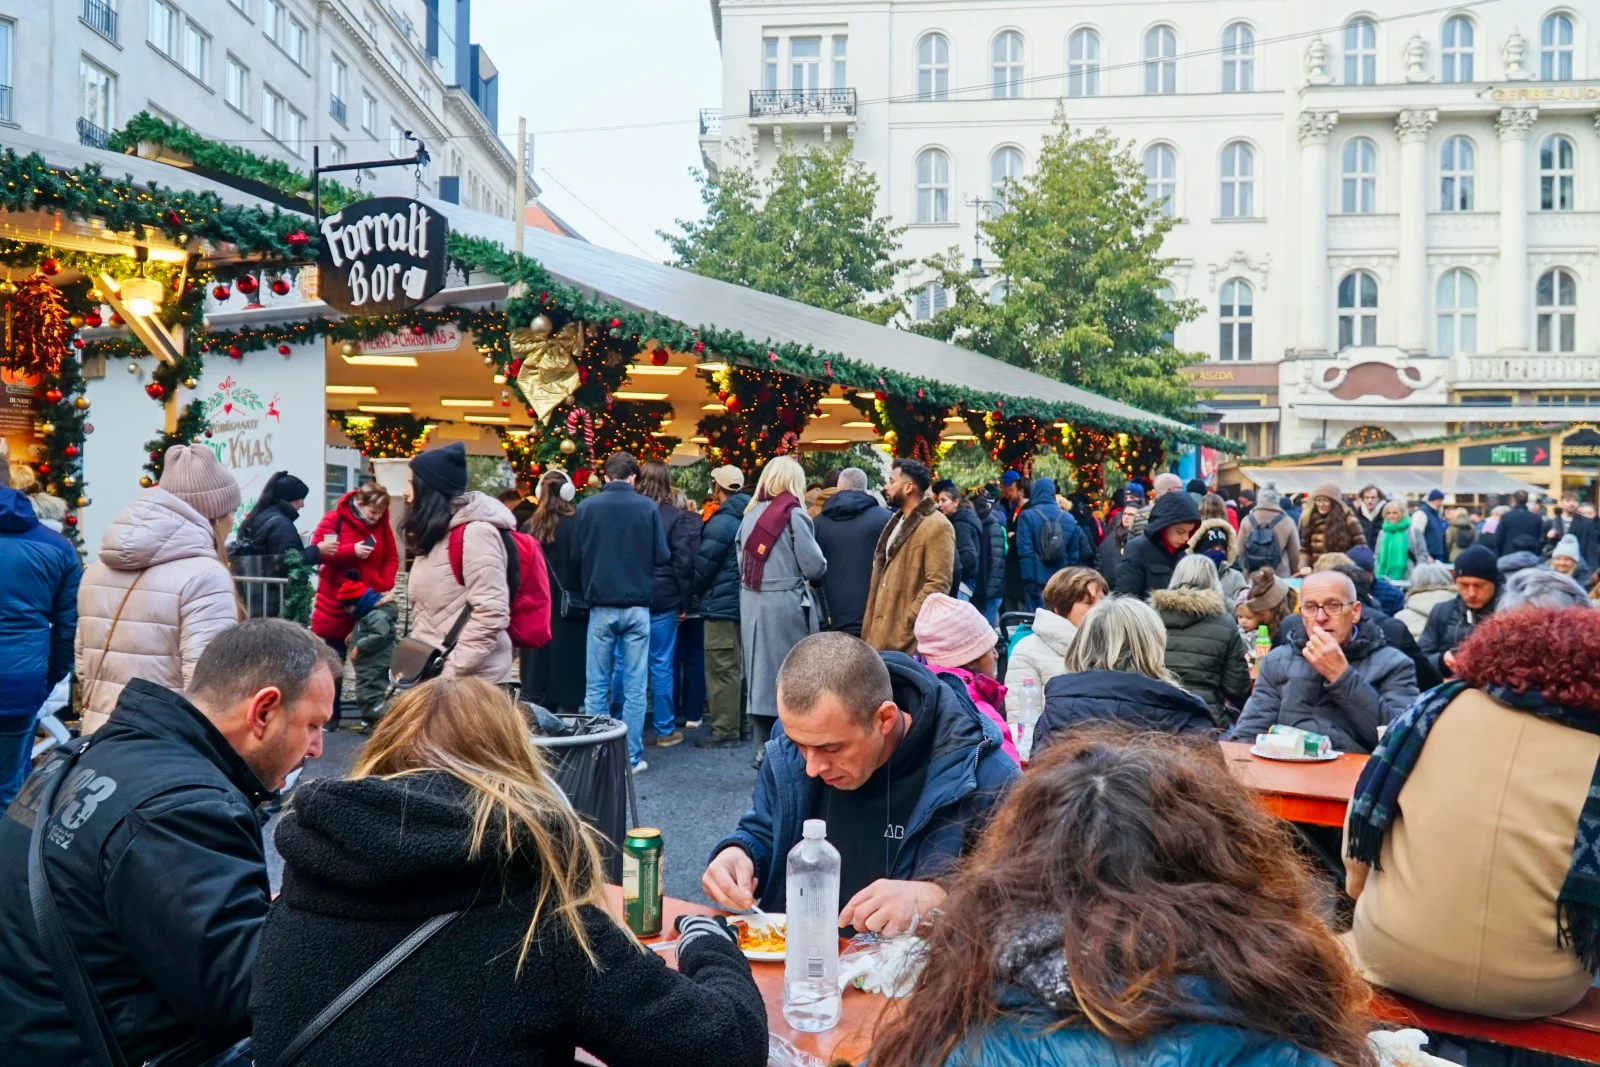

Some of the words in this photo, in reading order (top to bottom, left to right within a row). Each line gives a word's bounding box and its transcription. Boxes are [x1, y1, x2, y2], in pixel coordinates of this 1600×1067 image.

[1491, 87, 1599, 101] GERBEAUD
[319, 202, 431, 268] Forralt
[347, 260, 402, 306] Bor
[362, 332, 391, 351] MERRY
[226, 431, 274, 469] XMAS
